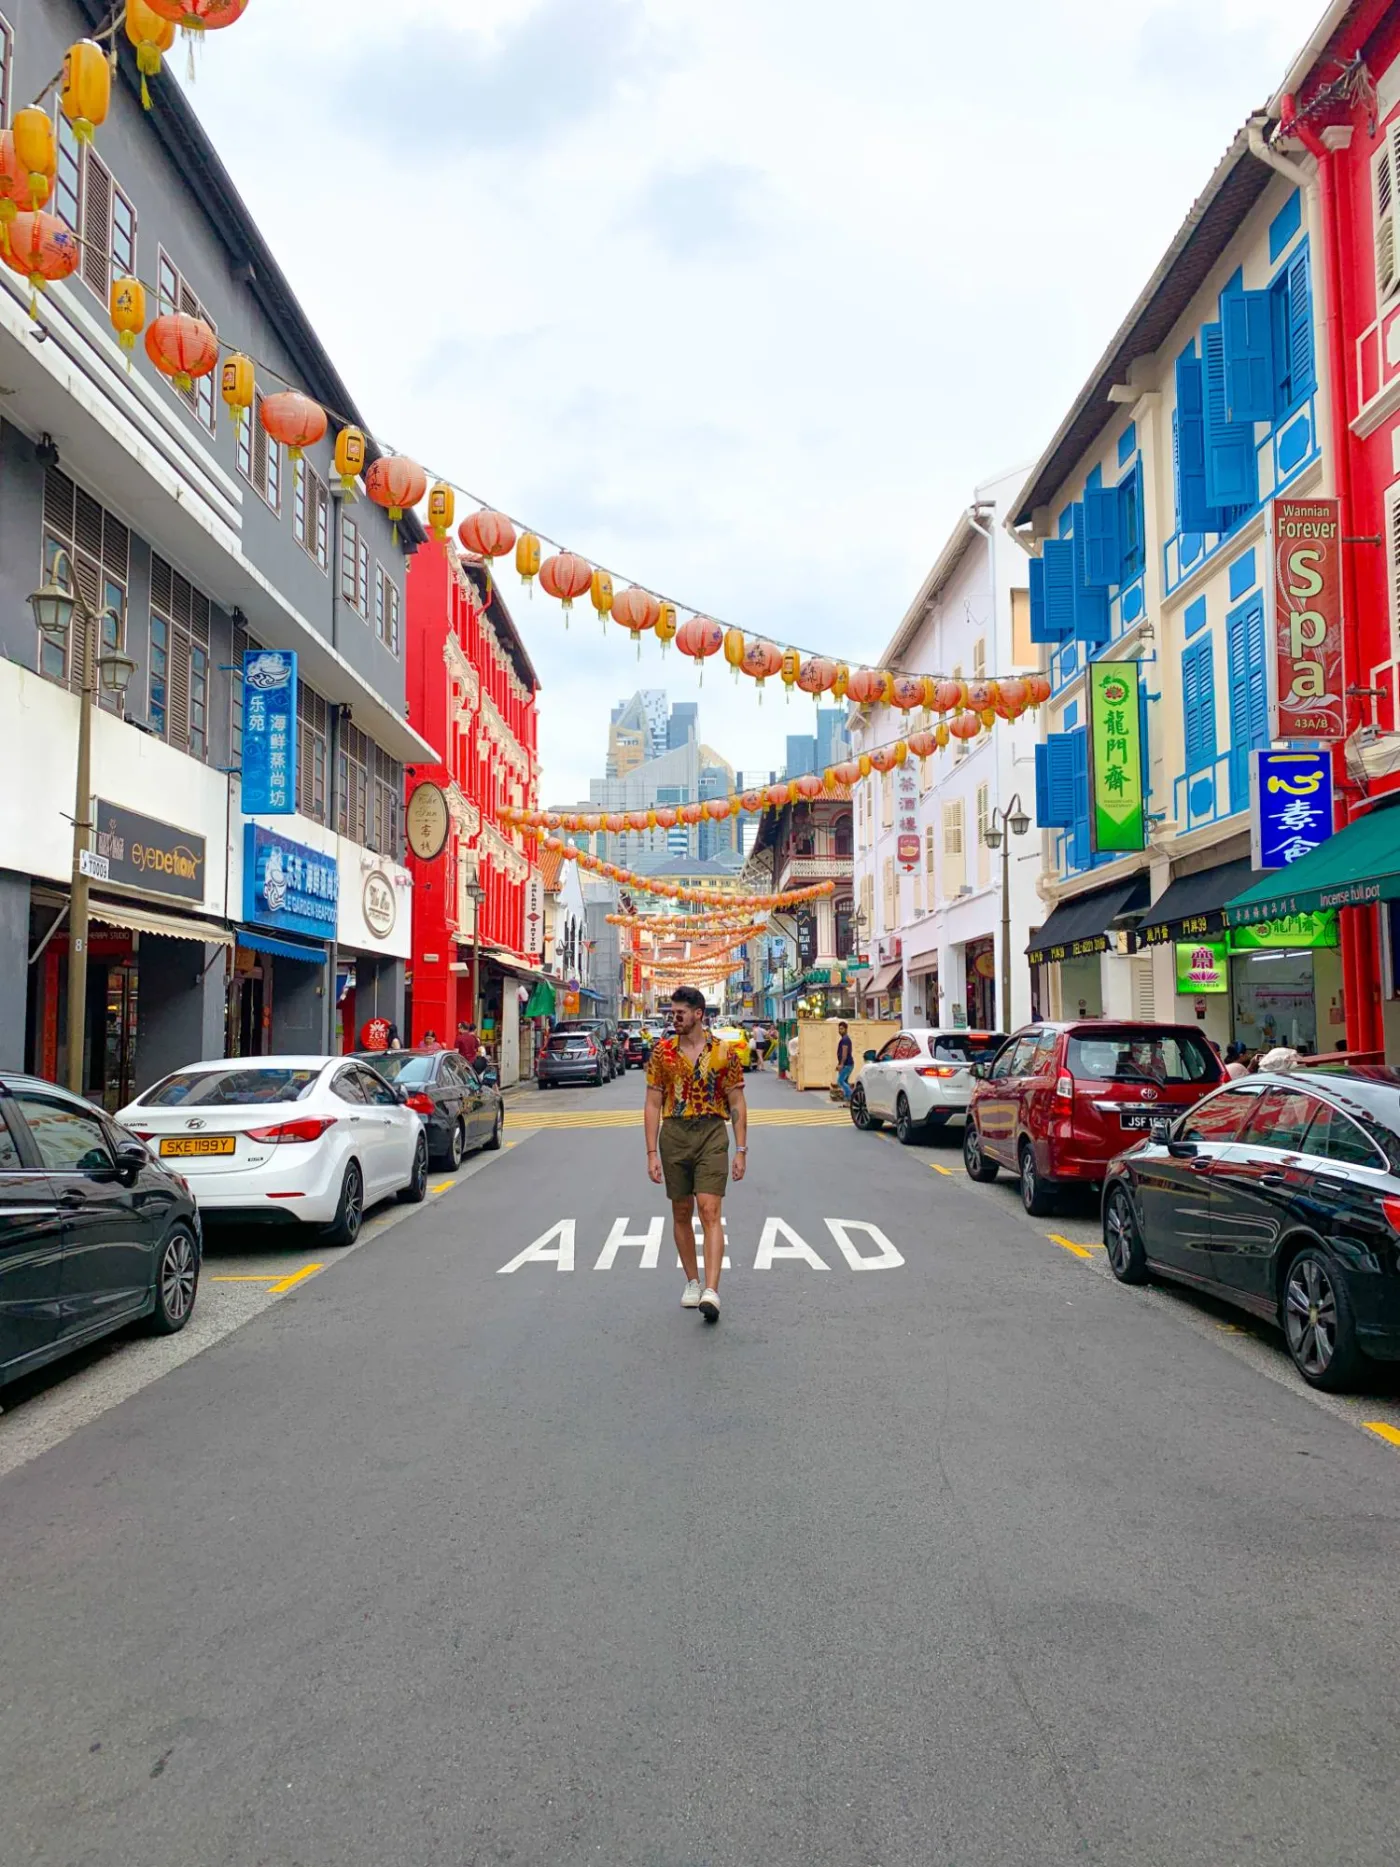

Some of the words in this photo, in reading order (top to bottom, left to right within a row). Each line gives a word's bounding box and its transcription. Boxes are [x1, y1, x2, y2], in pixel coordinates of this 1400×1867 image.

[1283, 504, 1330, 517] Wannian
[1278, 518, 1337, 538] Forever
[1288, 549, 1327, 698] Spa
[1294, 718, 1329, 729] 43A/B
[89, 860, 108, 879] T0009
[1320, 888, 1349, 907] Incense
[1364, 883, 1381, 901] pot
[75, 938, 83, 952] 8
[369, 1031, 387, 1039] ZEN
[1128, 1116, 1147, 1128] JSF
[167, 1141, 191, 1153] SKE
[194, 1140, 218, 1152] 1199
[221, 1139, 229, 1151] Y
